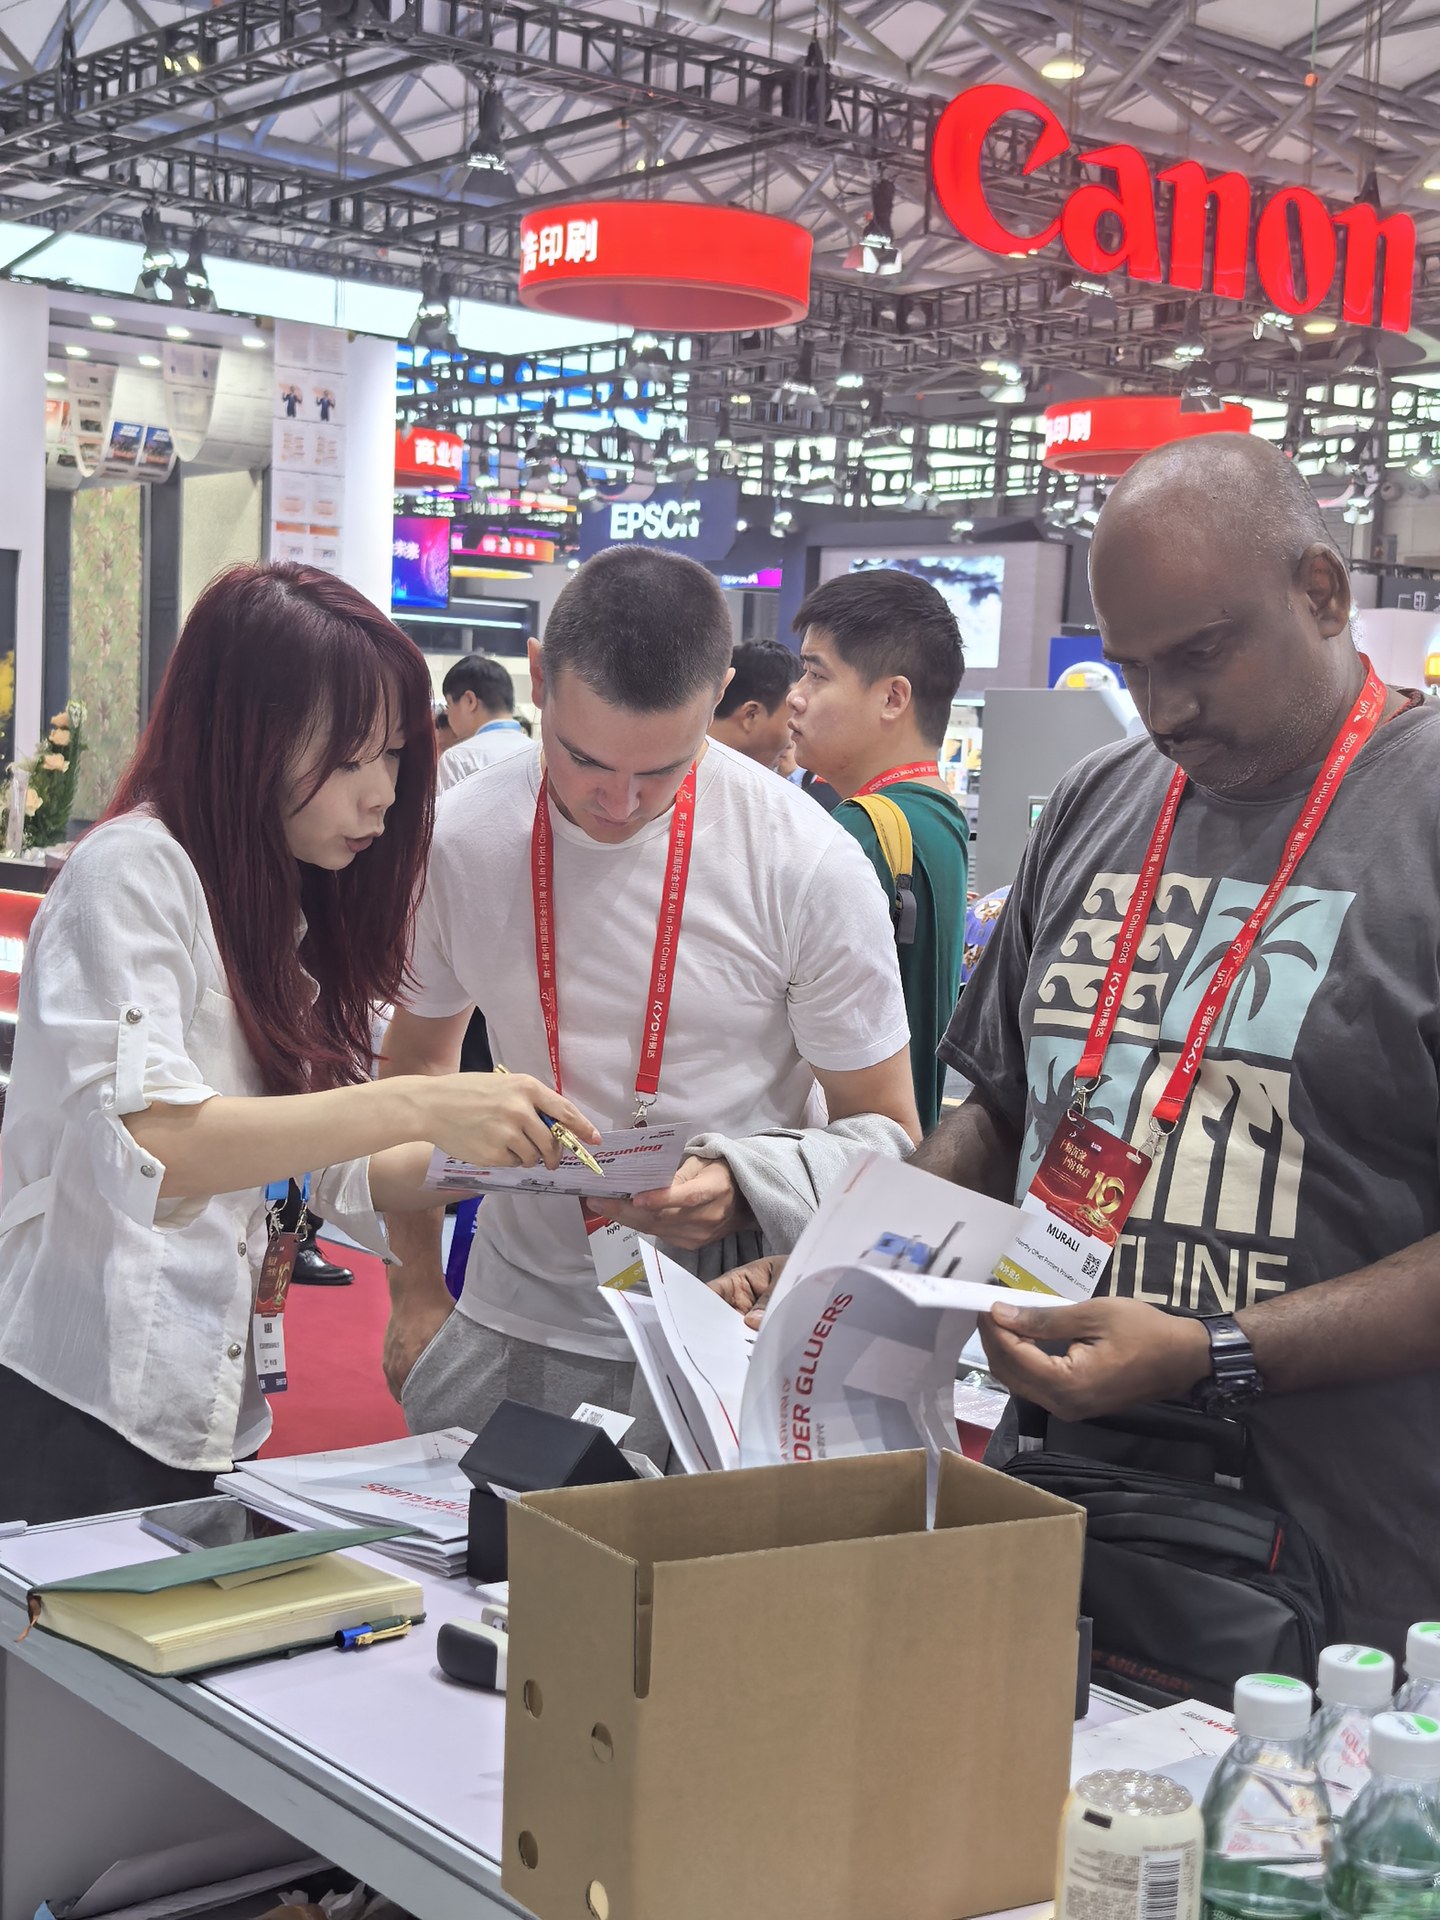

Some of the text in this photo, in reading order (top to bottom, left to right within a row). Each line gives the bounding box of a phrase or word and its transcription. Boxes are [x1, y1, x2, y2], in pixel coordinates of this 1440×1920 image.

[932, 84, 1416, 334] Canon
[1302, 815, 1314, 829] All
[1314, 781, 1331, 804] Print
[1326, 756, 1345, 780] China
[1340, 732, 1359, 754] 2026
[538, 846, 546, 865] Print
[1135, 891, 1148, 911] Print
[662, 926, 674, 944] Print
[1125, 914, 1141, 939] China
[658, 946, 671, 970] China
[1118, 941, 1132, 964] 2026
[657, 972, 667, 993] 2026
[1105, 972, 1122, 1008] KYD
[651, 1000, 663, 1031] KYD
[1182, 1036, 1202, 1074] KYD
[594, 1144, 663, 1158] Counting
[1047, 1223, 1080, 1252] MURALI
[796, 1292, 853, 1395] GLUERS
